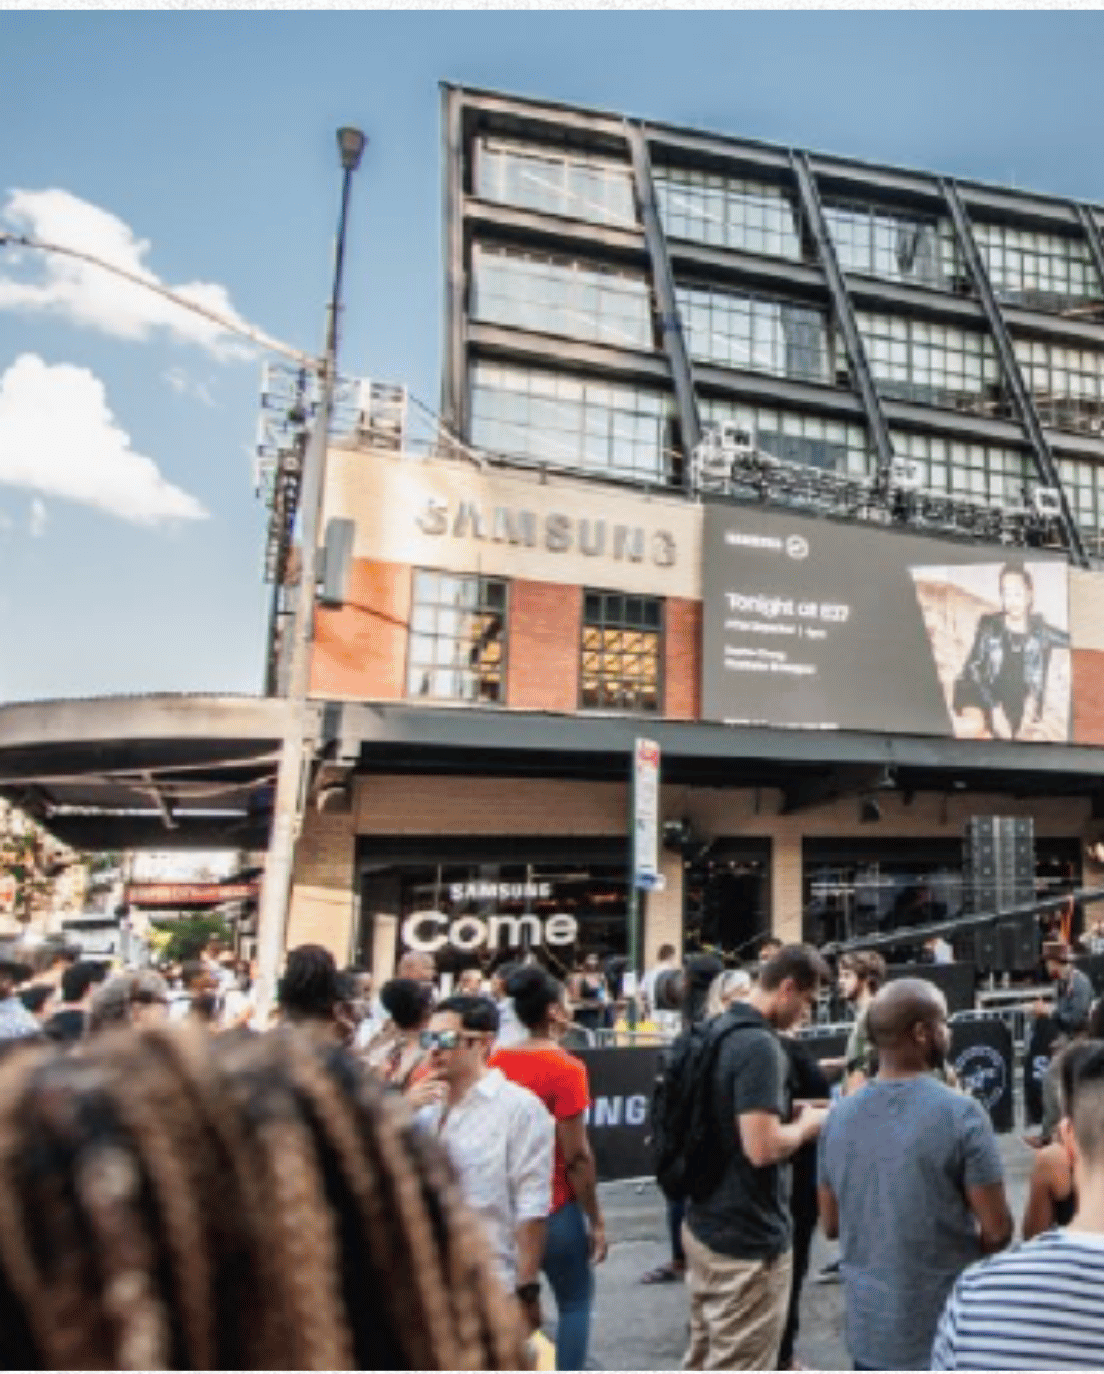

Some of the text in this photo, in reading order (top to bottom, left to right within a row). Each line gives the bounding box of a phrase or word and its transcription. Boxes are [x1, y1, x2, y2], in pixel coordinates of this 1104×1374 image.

[415, 498, 677, 567] SAMSUNG
[724, 592, 794, 618] Tonight
[450, 882, 552, 901] SAMSUNG
